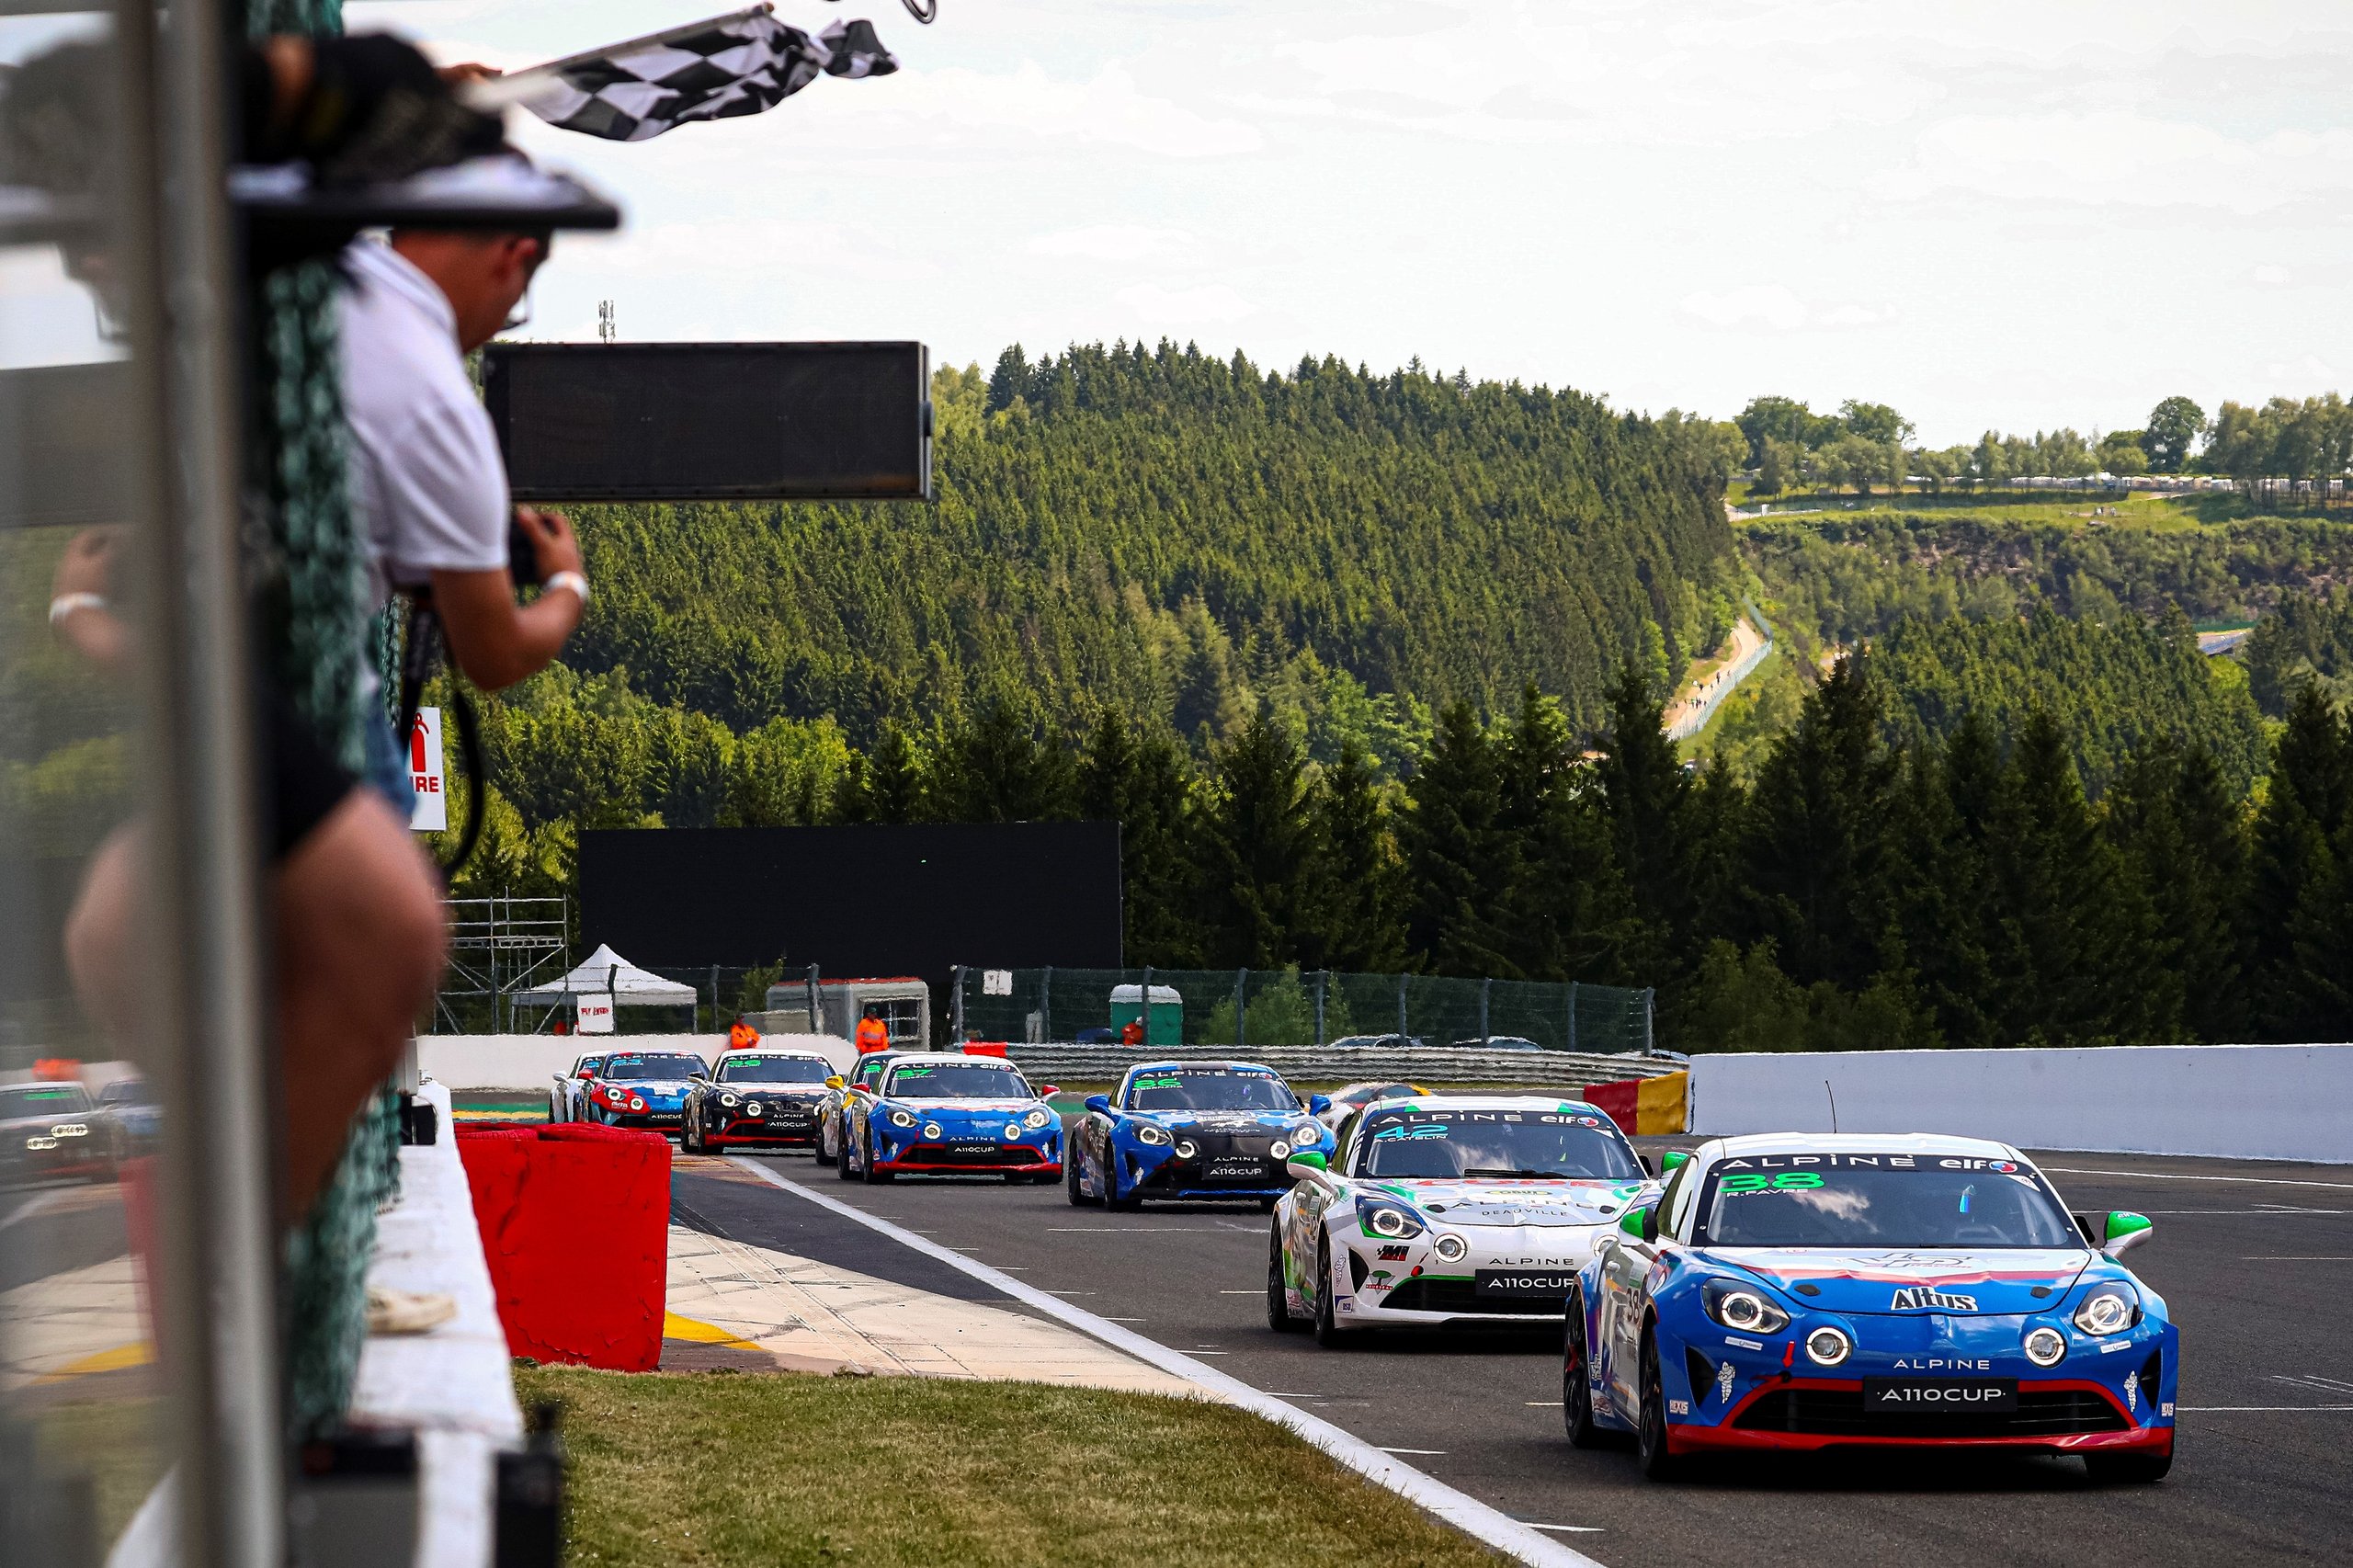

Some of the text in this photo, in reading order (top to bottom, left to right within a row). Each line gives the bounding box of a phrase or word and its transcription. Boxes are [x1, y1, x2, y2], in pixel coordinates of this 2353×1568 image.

[895, 1069, 934, 1078] 37
[1141, 1070, 1227, 1078] ALPINE
[1380, 1113, 1576, 1125] ALPINE elf
[1374, 1124, 1449, 1139] 42
[1722, 1153, 1987, 1170] ALPINE elf
[1720, 1172, 1825, 1194] 38
[1726, 1188, 1809, 1198] R.FAVRE
[1481, 1208, 1568, 1217] DEAUVILLE
[1489, 1257, 1574, 1266] ALPINE
[1893, 1287, 1978, 1312] Altus
[1626, 1287, 1640, 1325] 38
[1893, 1358, 1991, 1370] ALPINE
[1881, 1388, 2002, 1402] A110CUP
